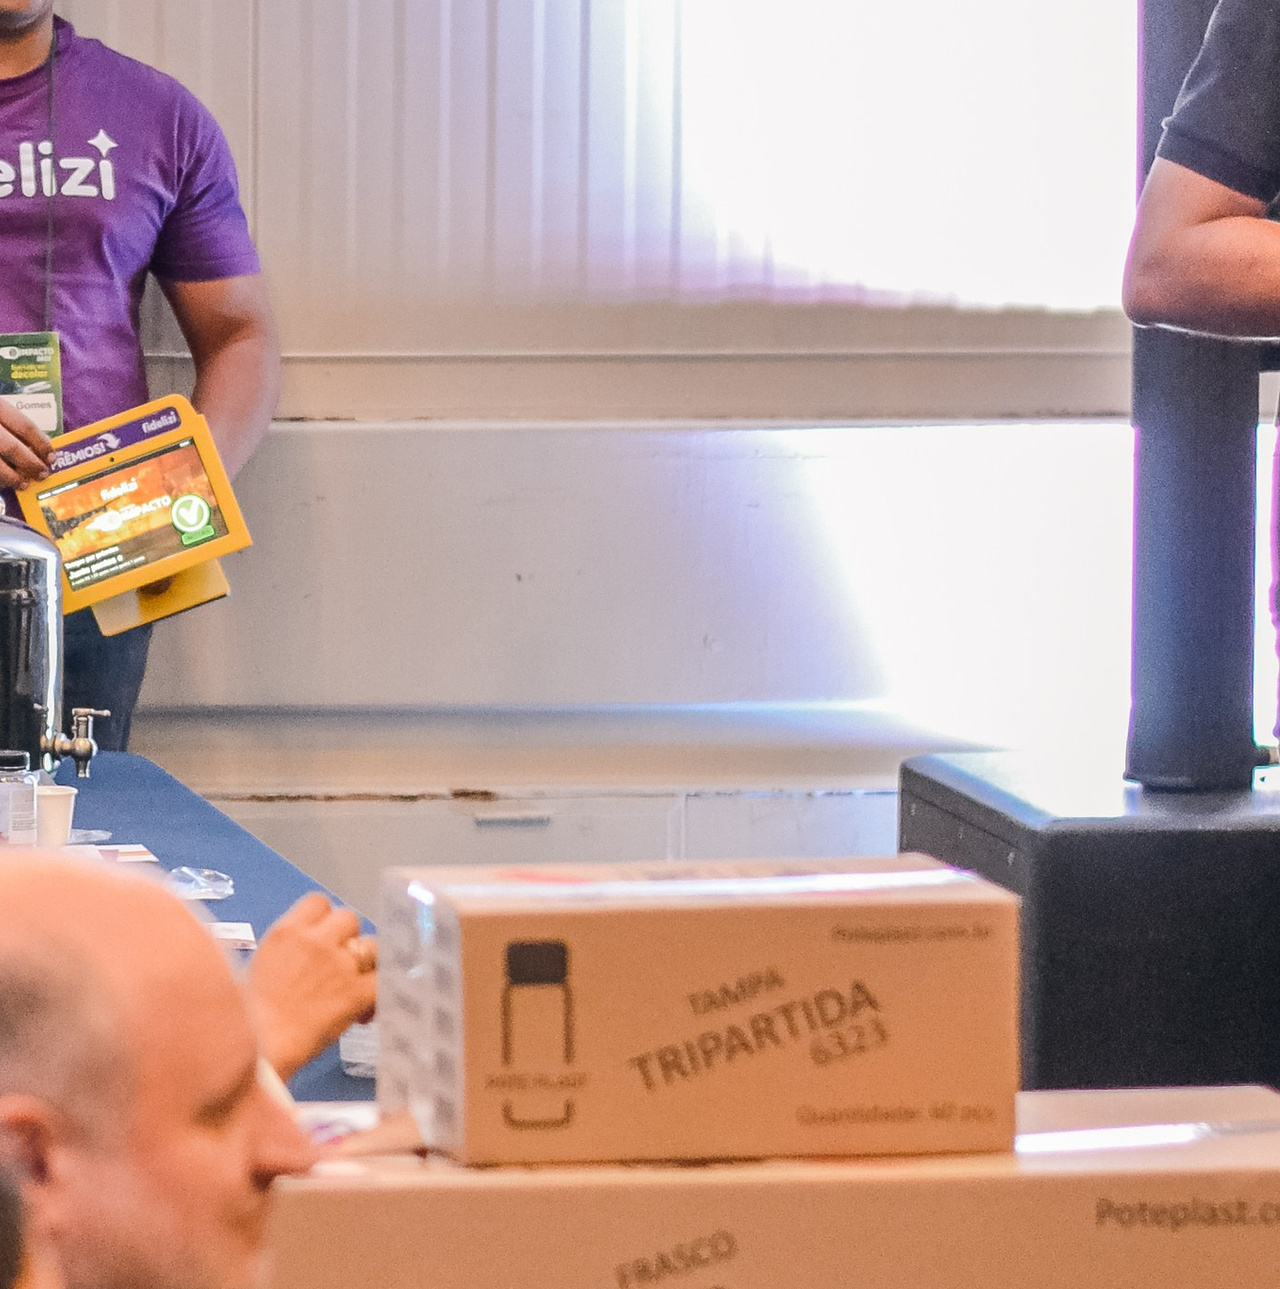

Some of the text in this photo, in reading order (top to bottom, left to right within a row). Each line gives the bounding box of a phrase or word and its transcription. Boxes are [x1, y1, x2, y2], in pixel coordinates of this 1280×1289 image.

[15, 401, 52, 410] Gomes
[142, 410, 178, 434] fidelizi
[685, 966, 786, 1016] TAMPA
[628, 977, 881, 1091] TRIPARTIDA
[1095, 1196, 1280, 1233] Poteplast.c
